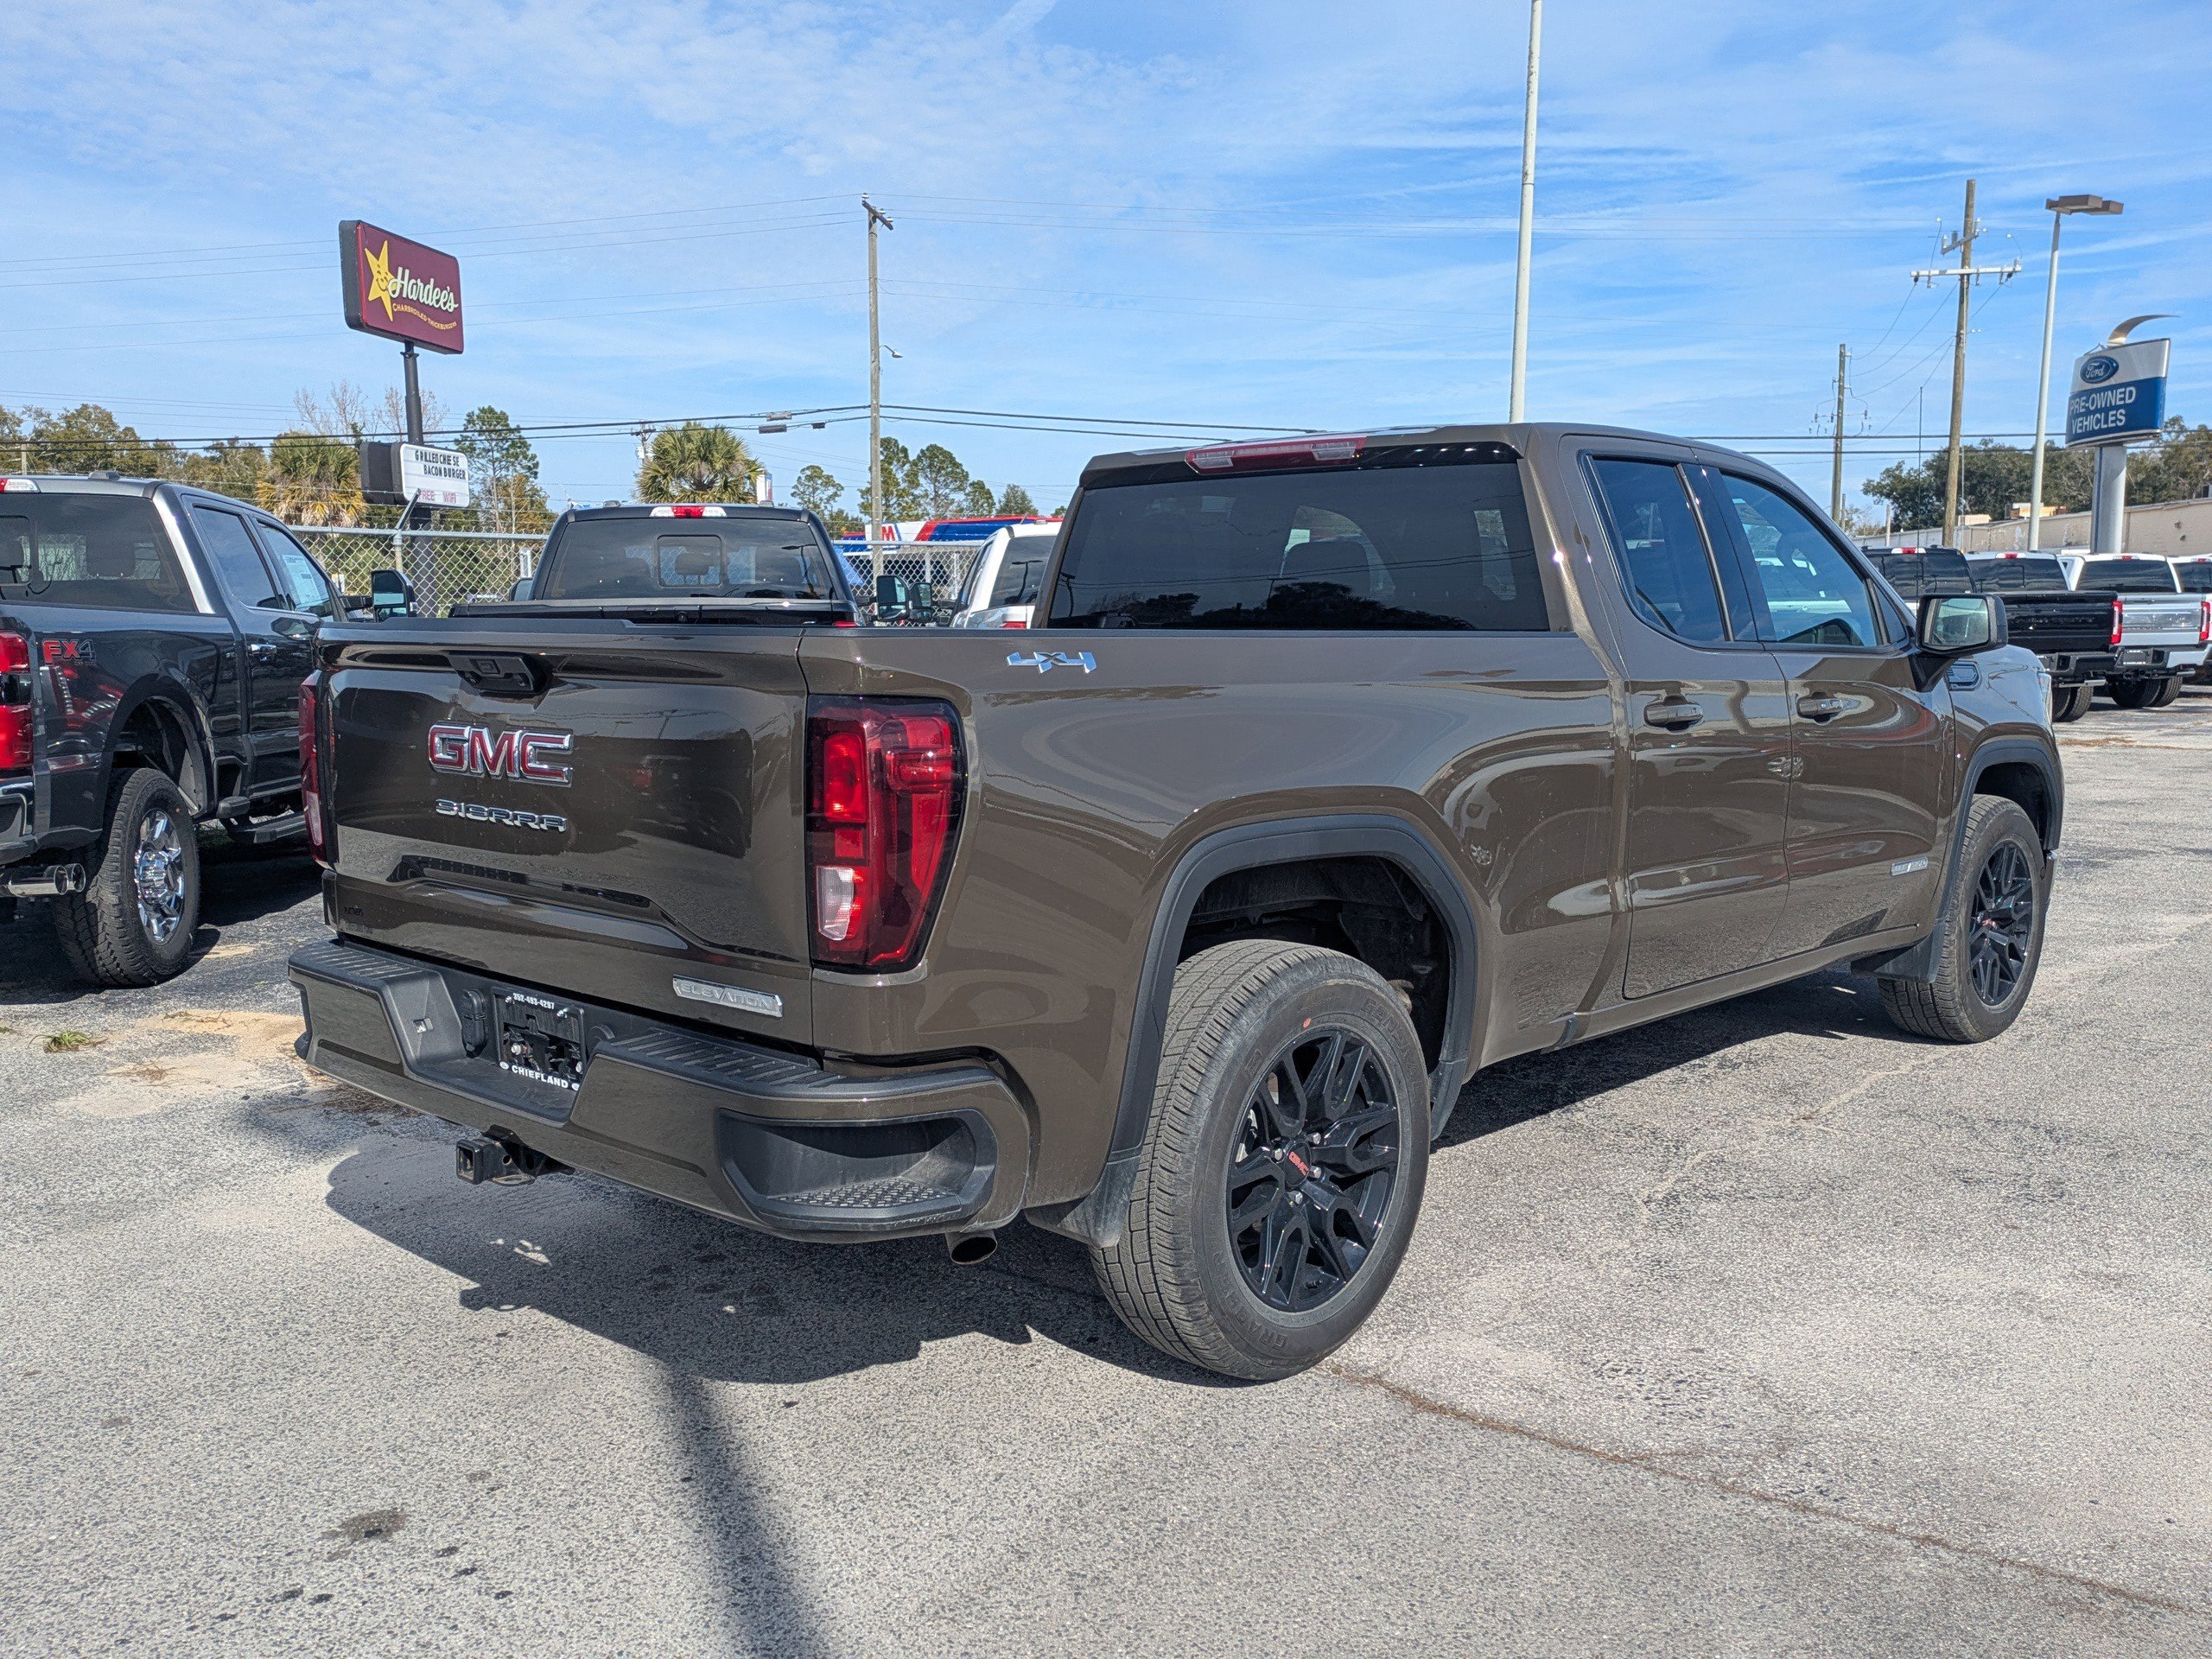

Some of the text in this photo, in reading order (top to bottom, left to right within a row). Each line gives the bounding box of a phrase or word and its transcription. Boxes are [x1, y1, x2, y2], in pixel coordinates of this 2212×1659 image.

[388, 267, 459, 313] Hardee's
[2085, 362, 2106, 378] Ford
[2069, 386, 2137, 415] PRE-OWNED
[2072, 409, 2126, 434] VEHICLES
[415, 450, 438, 464] GRILLED
[423, 465, 466, 480] BACON BURGER
[42, 639, 96, 666] FX4
[428, 722, 574, 788] GMC
[435, 798, 567, 834] SIERRA
[678, 981, 776, 1012] ELEVATION
[511, 1065, 569, 1089] CHIEFLAND
[1288, 1151, 1309, 1176] GMC
